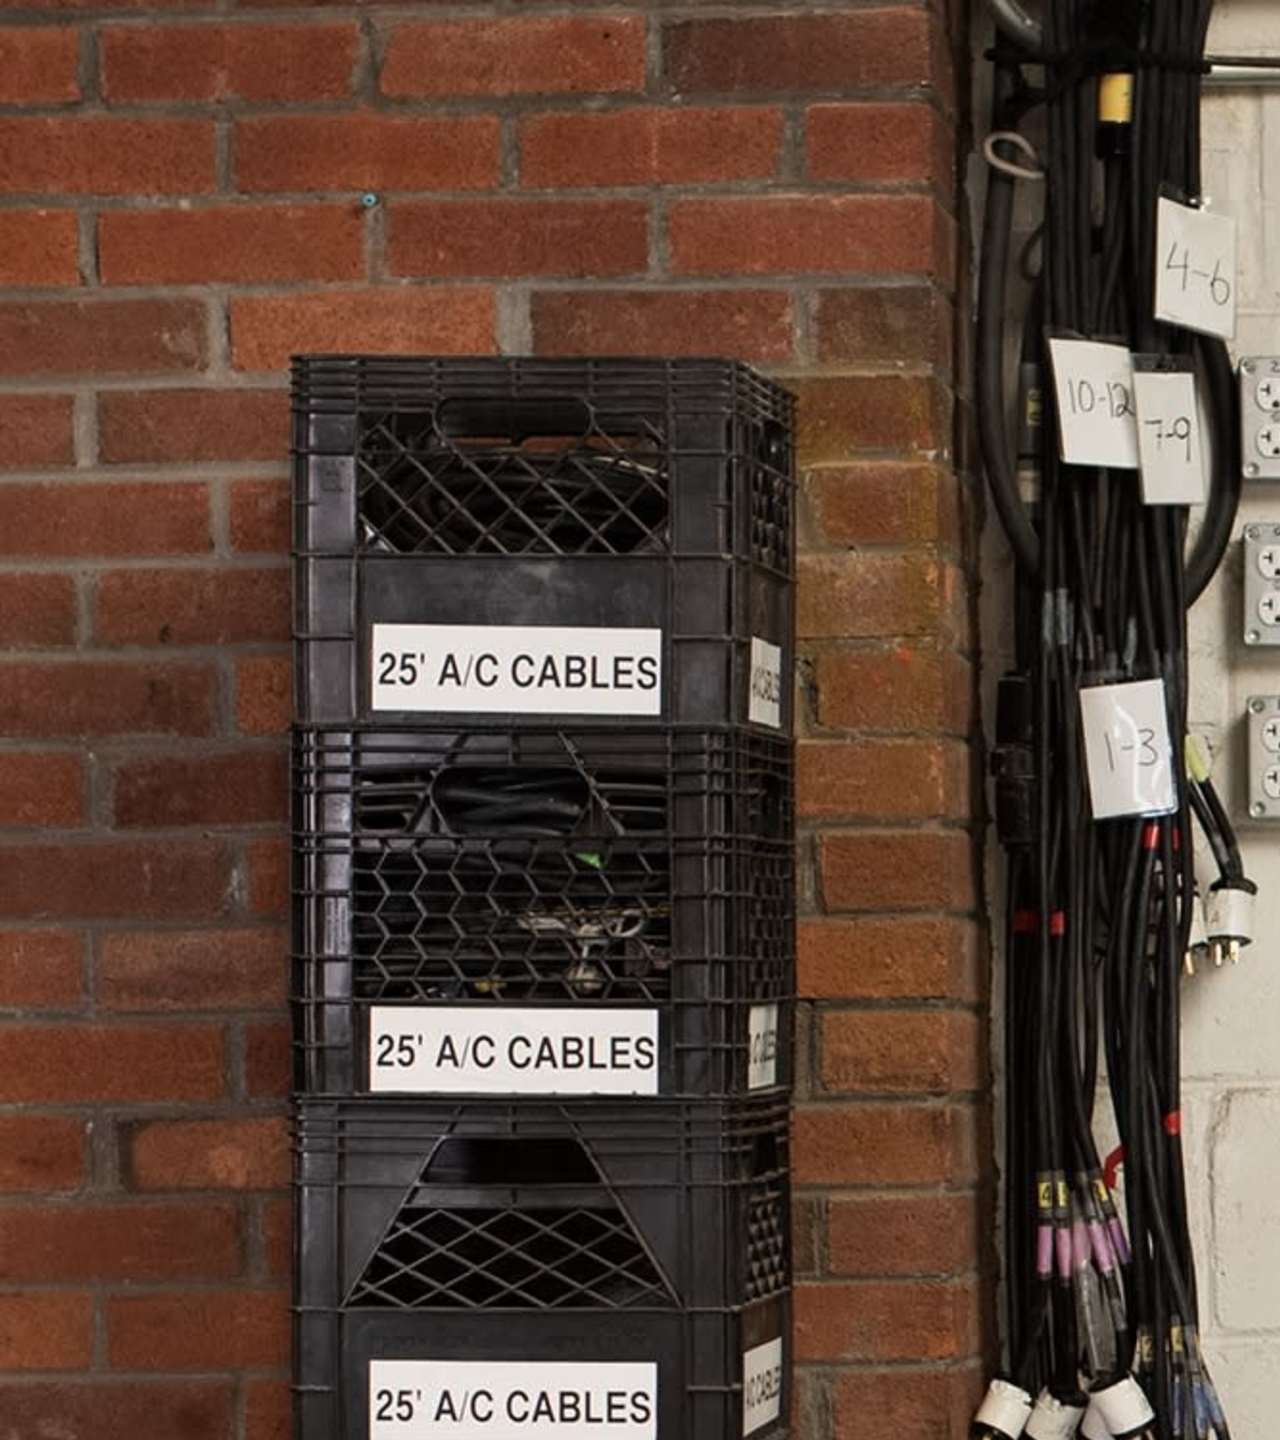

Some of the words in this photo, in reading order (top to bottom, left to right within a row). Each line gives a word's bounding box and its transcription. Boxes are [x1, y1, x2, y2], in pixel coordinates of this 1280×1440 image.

[1164, 240, 1231, 307] 4-6
[1067, 376, 1134, 419] 10-12
[1145, 418, 1193, 462] 7-9
[378, 653, 426, 686] 25'
[438, 654, 499, 687] A/C
[510, 656, 658, 689] CABLES
[1103, 728, 1160, 772] 1-3
[376, 1033, 424, 1066] 25'
[435, 1035, 496, 1068] A/C
[507, 1036, 656, 1069] CABLES
[375, 1389, 423, 1422] 25'
[434, 1389, 494, 1422] A/C
[506, 1390, 652, 1423] CABLES
